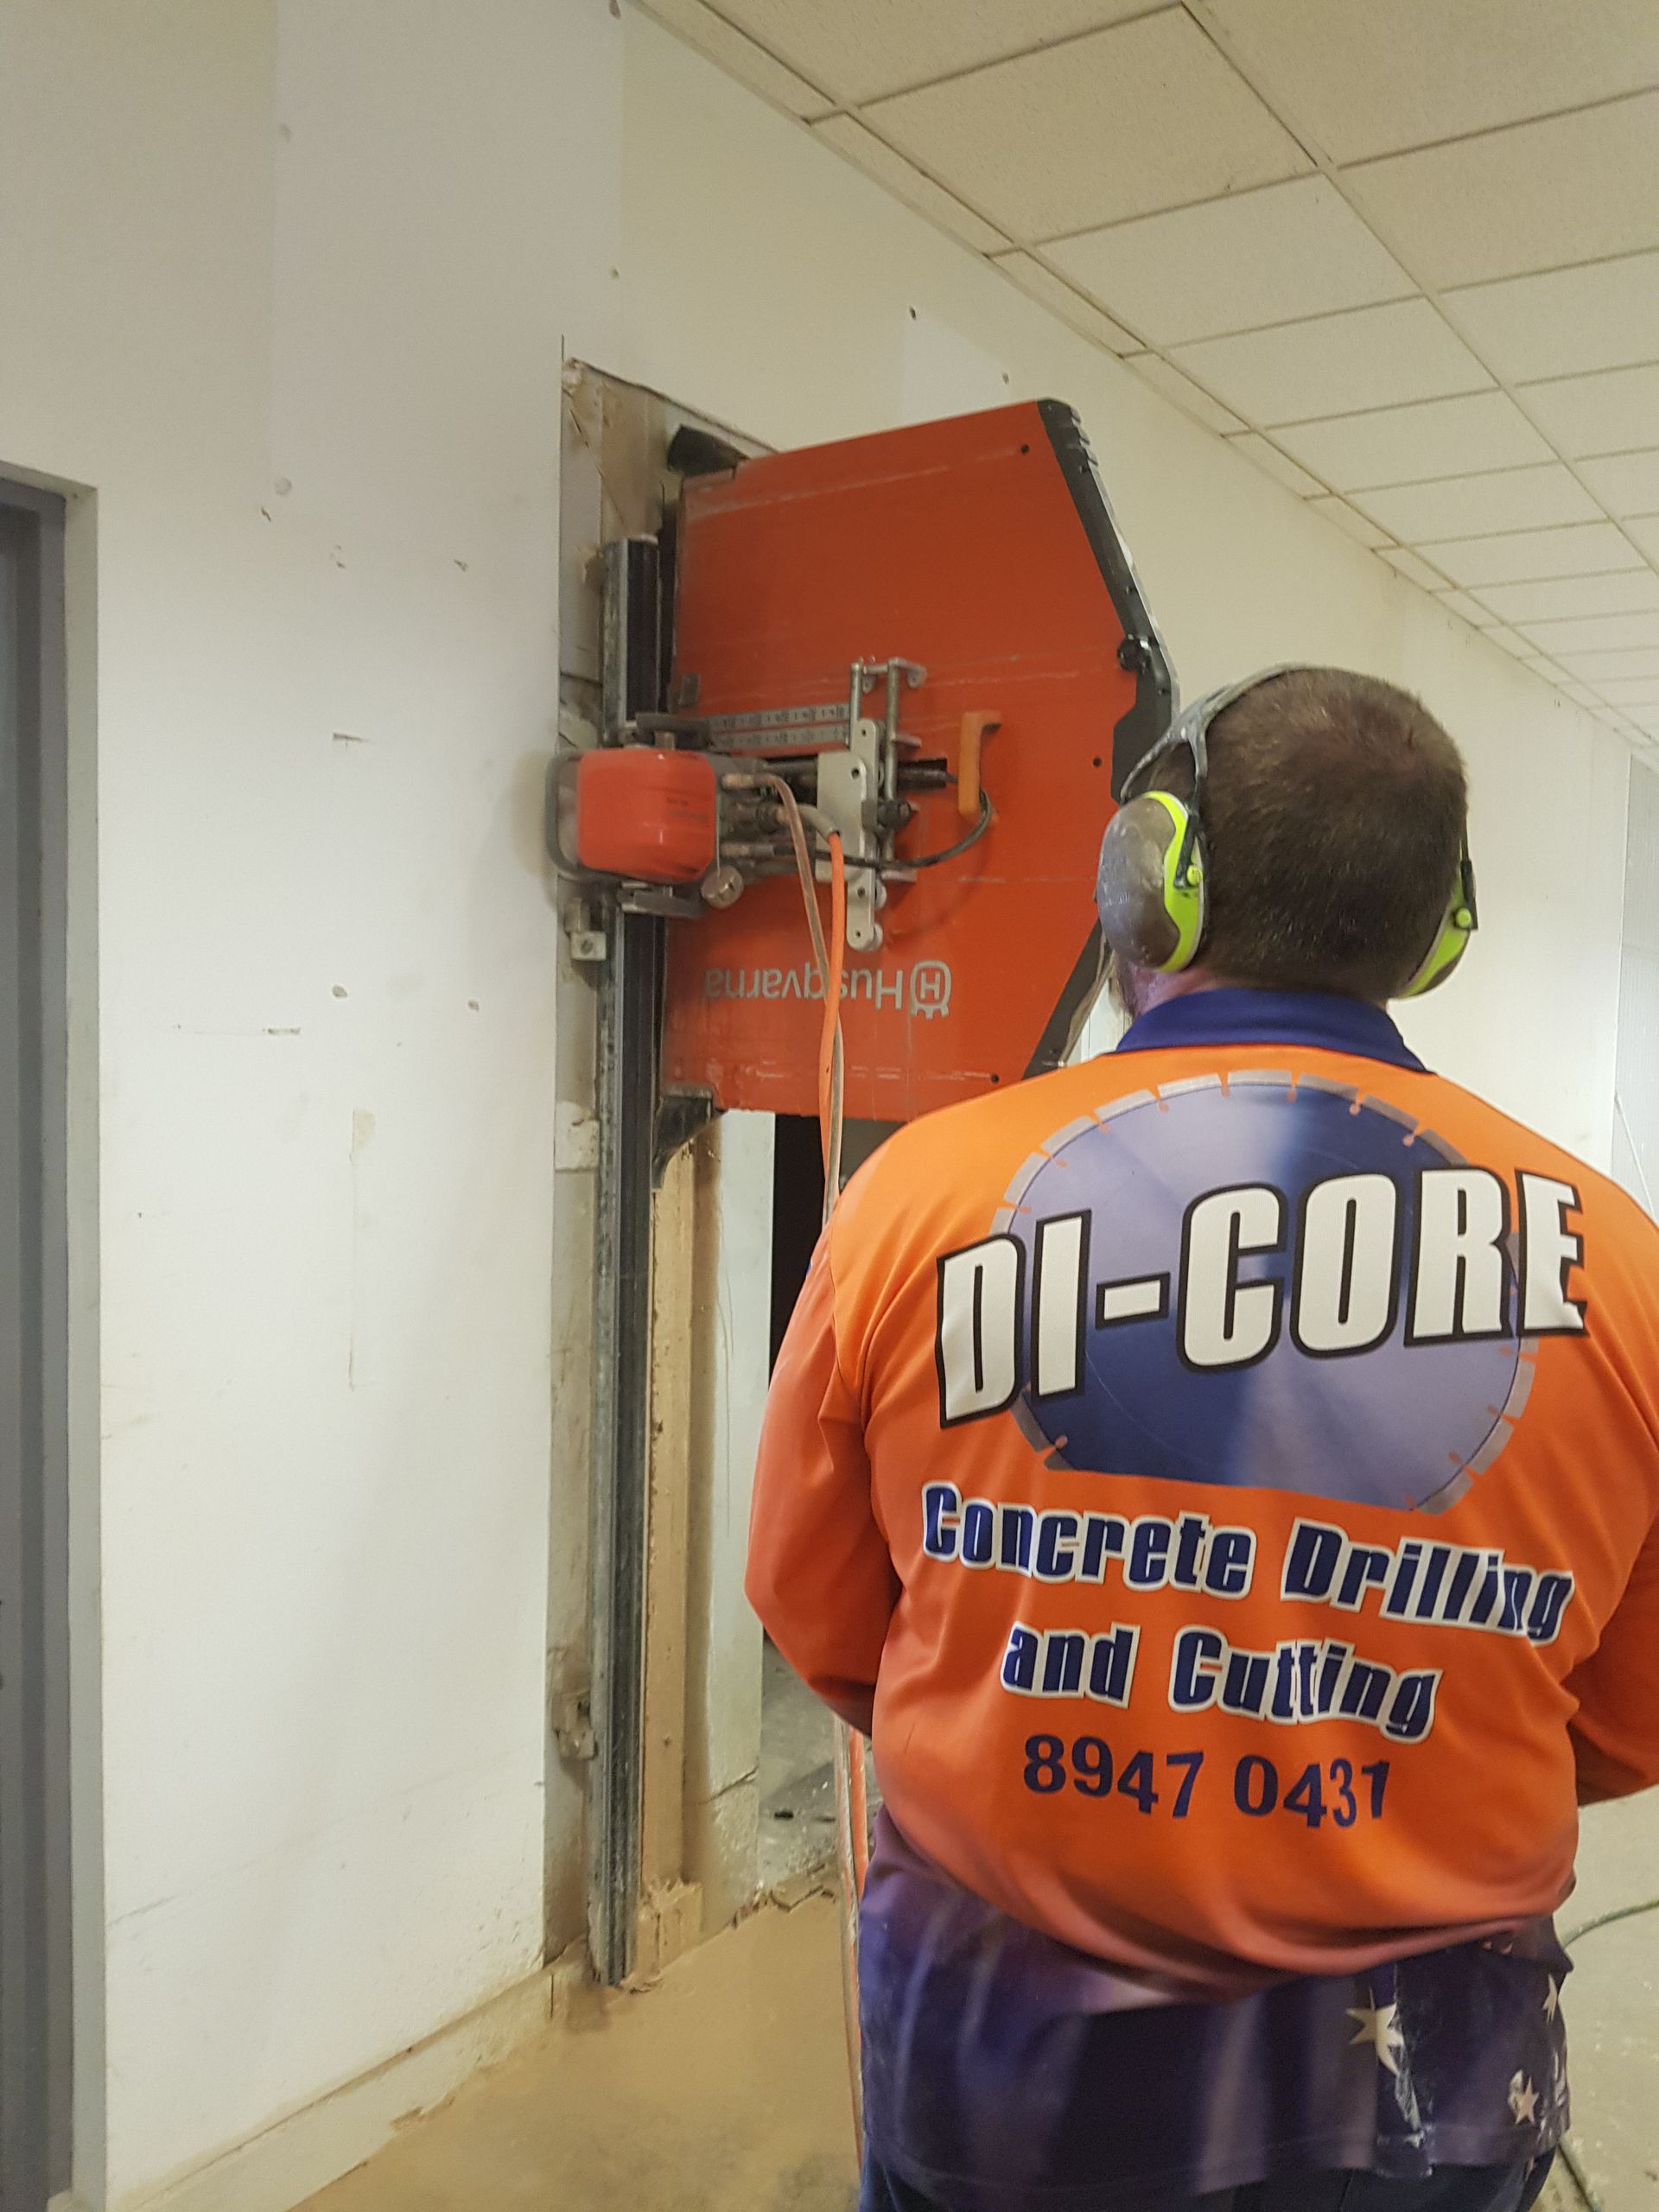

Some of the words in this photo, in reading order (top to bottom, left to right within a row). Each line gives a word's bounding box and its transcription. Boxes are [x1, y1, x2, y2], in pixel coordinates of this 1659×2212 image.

[936, 1166, 1588, 1428] DI-CORE
[922, 1482, 1256, 1598] Concrete
[1281, 1518, 1574, 1644] Drilling
[1001, 1623, 1141, 1707] and
[1168, 1626, 1443, 1743] Cutting
[1023, 1735, 1205, 1817] 8947
[1233, 1755, 1391, 1828] 0431
